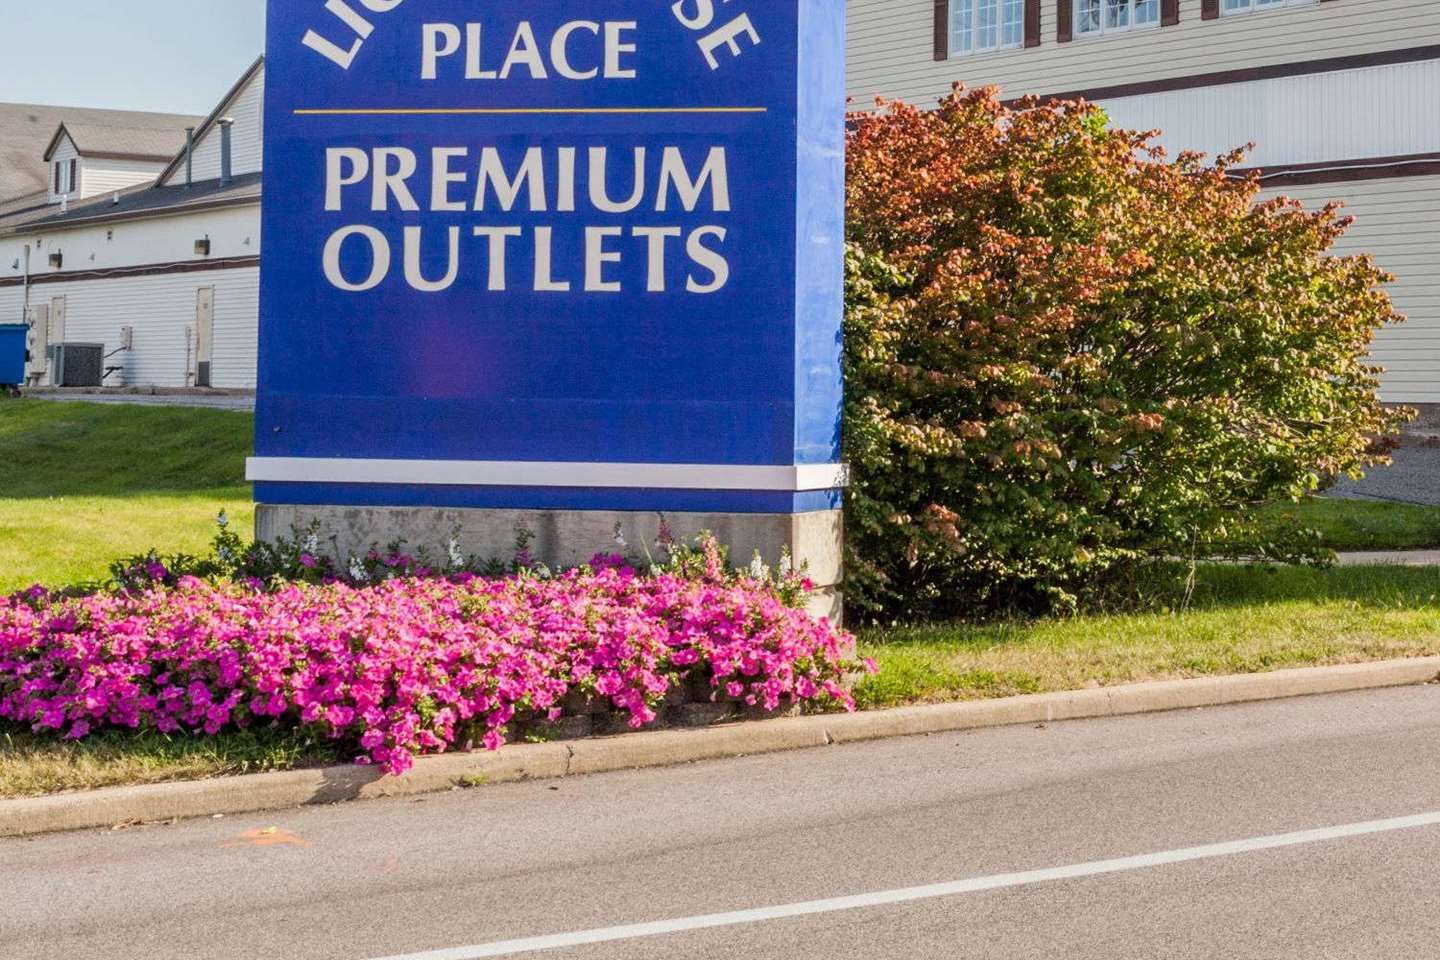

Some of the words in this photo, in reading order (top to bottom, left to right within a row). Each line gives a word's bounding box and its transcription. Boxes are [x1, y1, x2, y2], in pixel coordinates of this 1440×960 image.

[420, 20, 638, 81] PLACE
[324, 146, 731, 213] PREMIUM
[322, 224, 730, 294] OUTLETS
